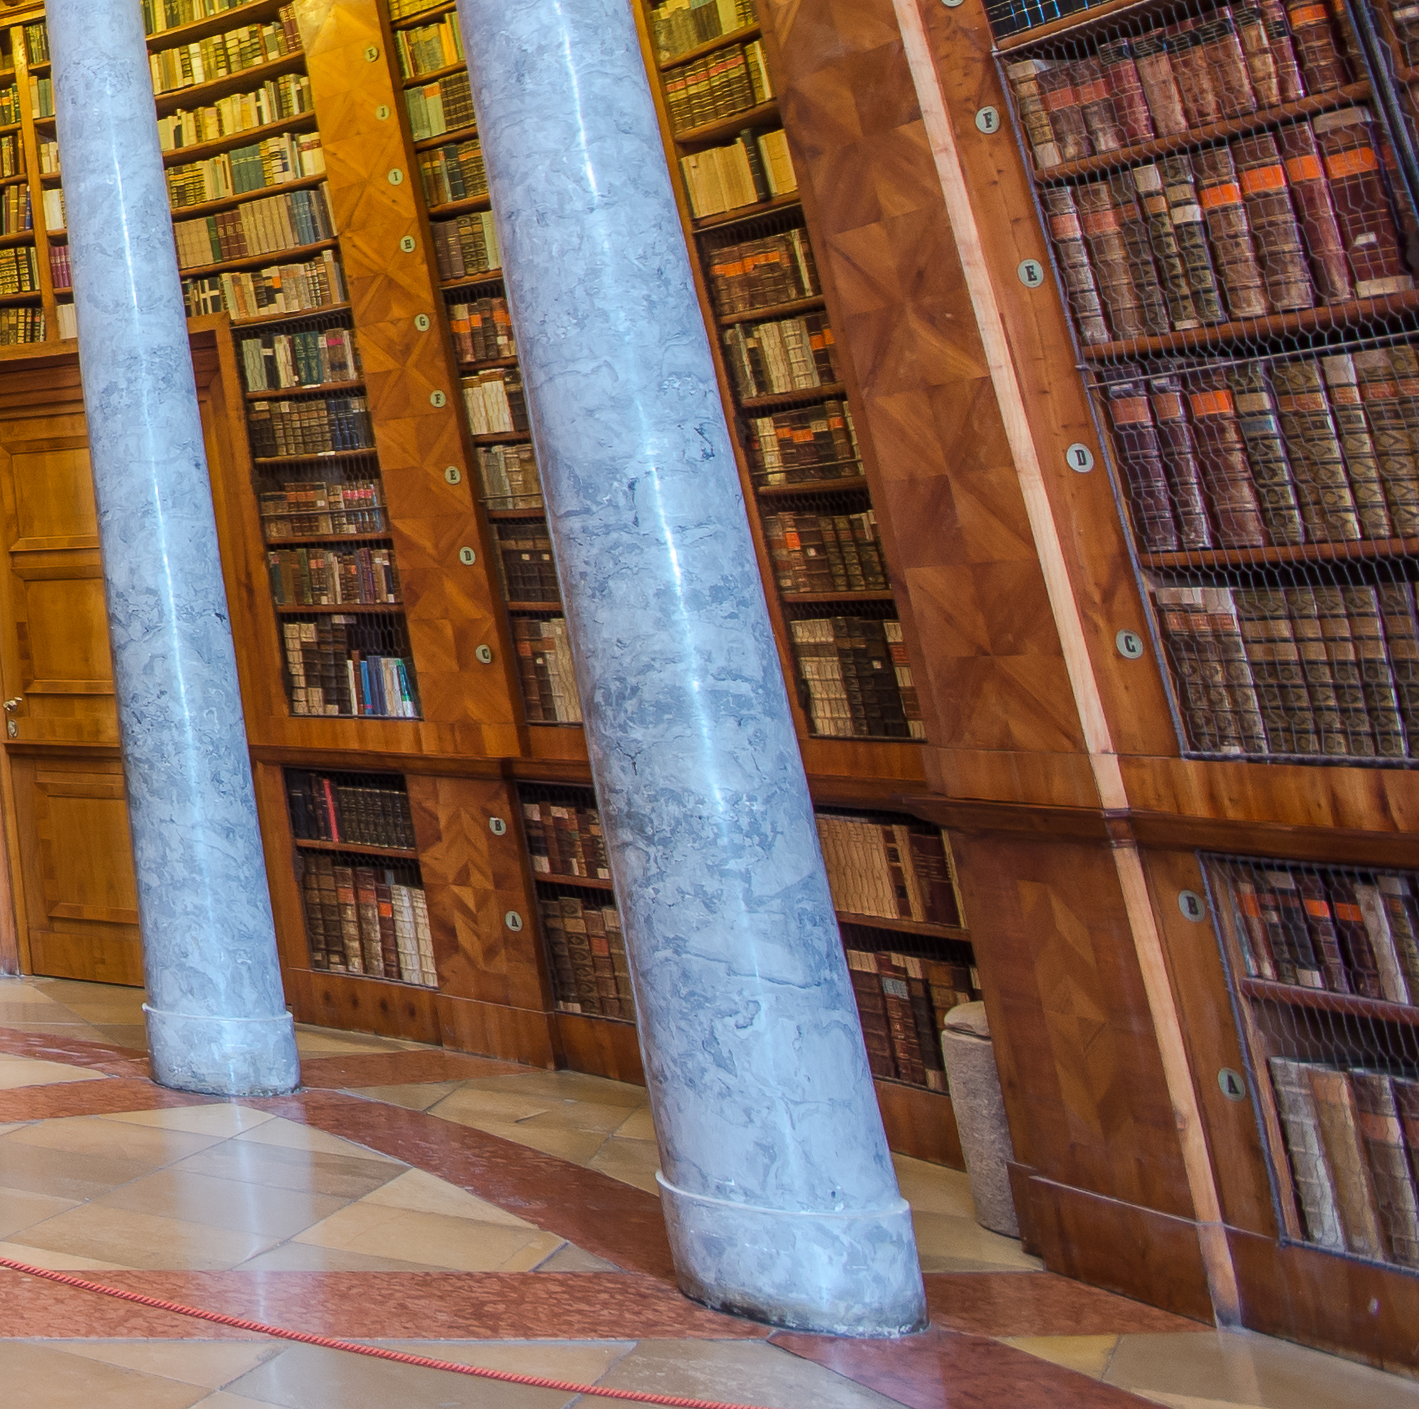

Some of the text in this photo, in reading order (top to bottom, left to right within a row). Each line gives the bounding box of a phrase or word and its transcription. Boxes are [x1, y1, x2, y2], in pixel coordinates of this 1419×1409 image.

[367, 49, 375, 59] K
[982, 112, 992, 128] F
[393, 171, 399, 181] I
[404, 239, 412, 249] H
[1024, 265, 1038, 282] E
[419, 316, 426, 326] G
[434, 393, 441, 404] F
[1074, 449, 1087, 466] D
[450, 470, 457, 480] E
[463, 550, 472, 561] D
[1124, 635, 1136, 653] C
[481, 648, 489, 659] C
[495, 819, 502, 831] B
[1186, 896, 1199, 915] B
[511, 915, 519, 928] A
[1227, 1074, 1241, 1094] A
